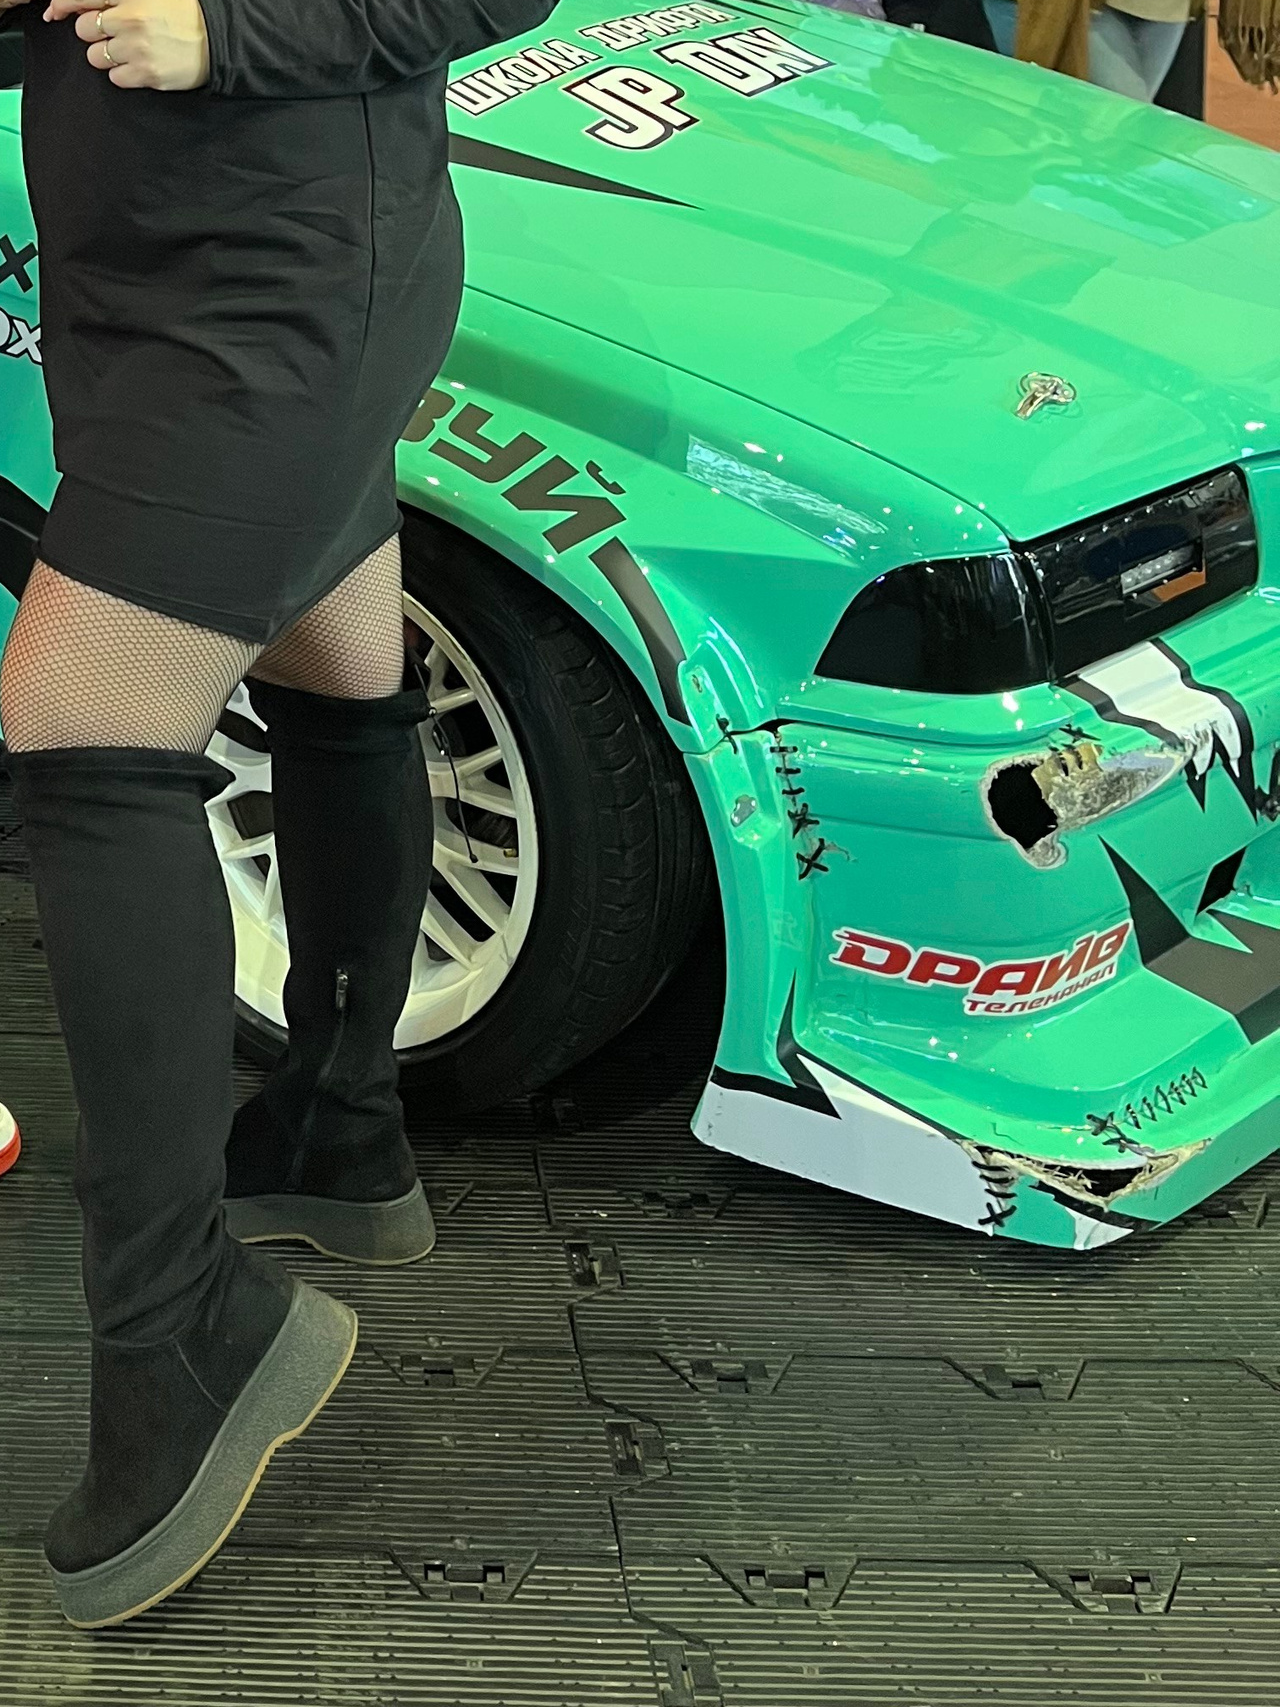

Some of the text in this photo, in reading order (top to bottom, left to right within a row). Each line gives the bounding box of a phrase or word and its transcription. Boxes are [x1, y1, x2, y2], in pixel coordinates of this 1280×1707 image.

[446, 1, 741, 116] ШКОЛА ДРИФТА
[563, 27, 836, 150] JP DAY
